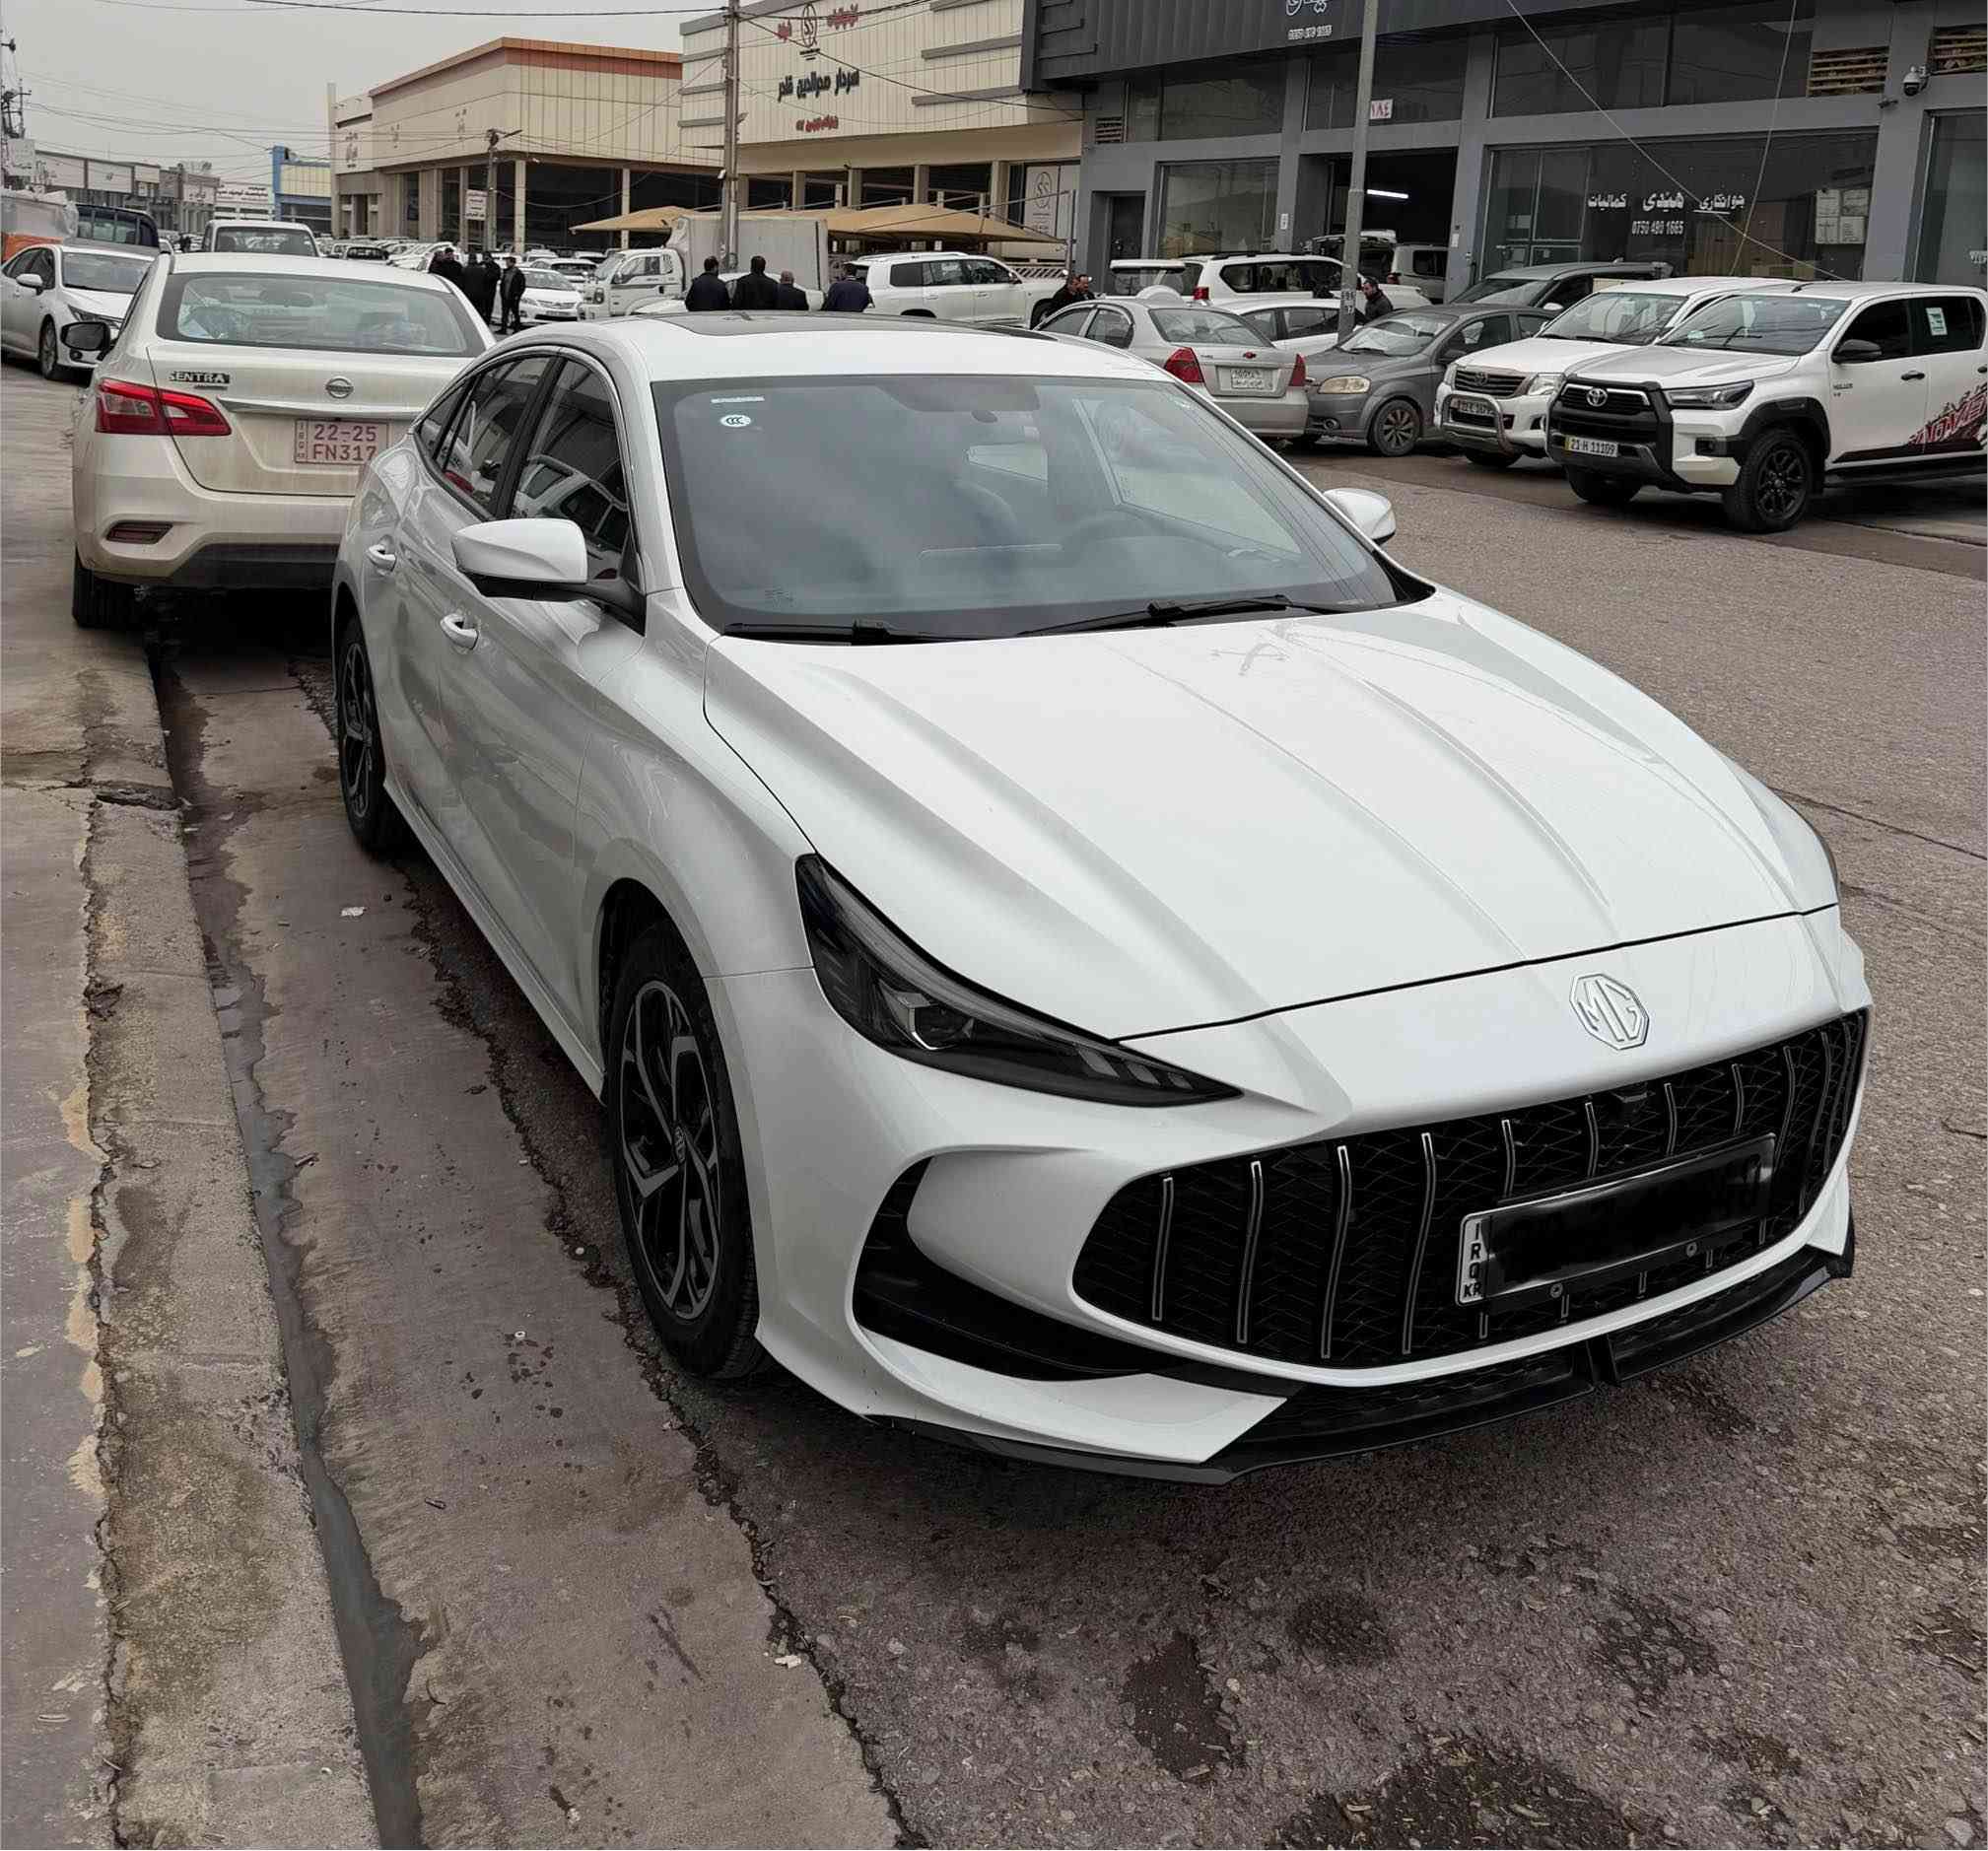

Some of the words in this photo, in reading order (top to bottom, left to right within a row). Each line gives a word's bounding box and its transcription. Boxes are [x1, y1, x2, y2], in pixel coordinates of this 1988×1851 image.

[169, 372, 230, 384] SENTRA
[312, 423, 377, 443] 22-25
[311, 444, 377, 461] FN317
[1575, 978, 1644, 1045] MG
